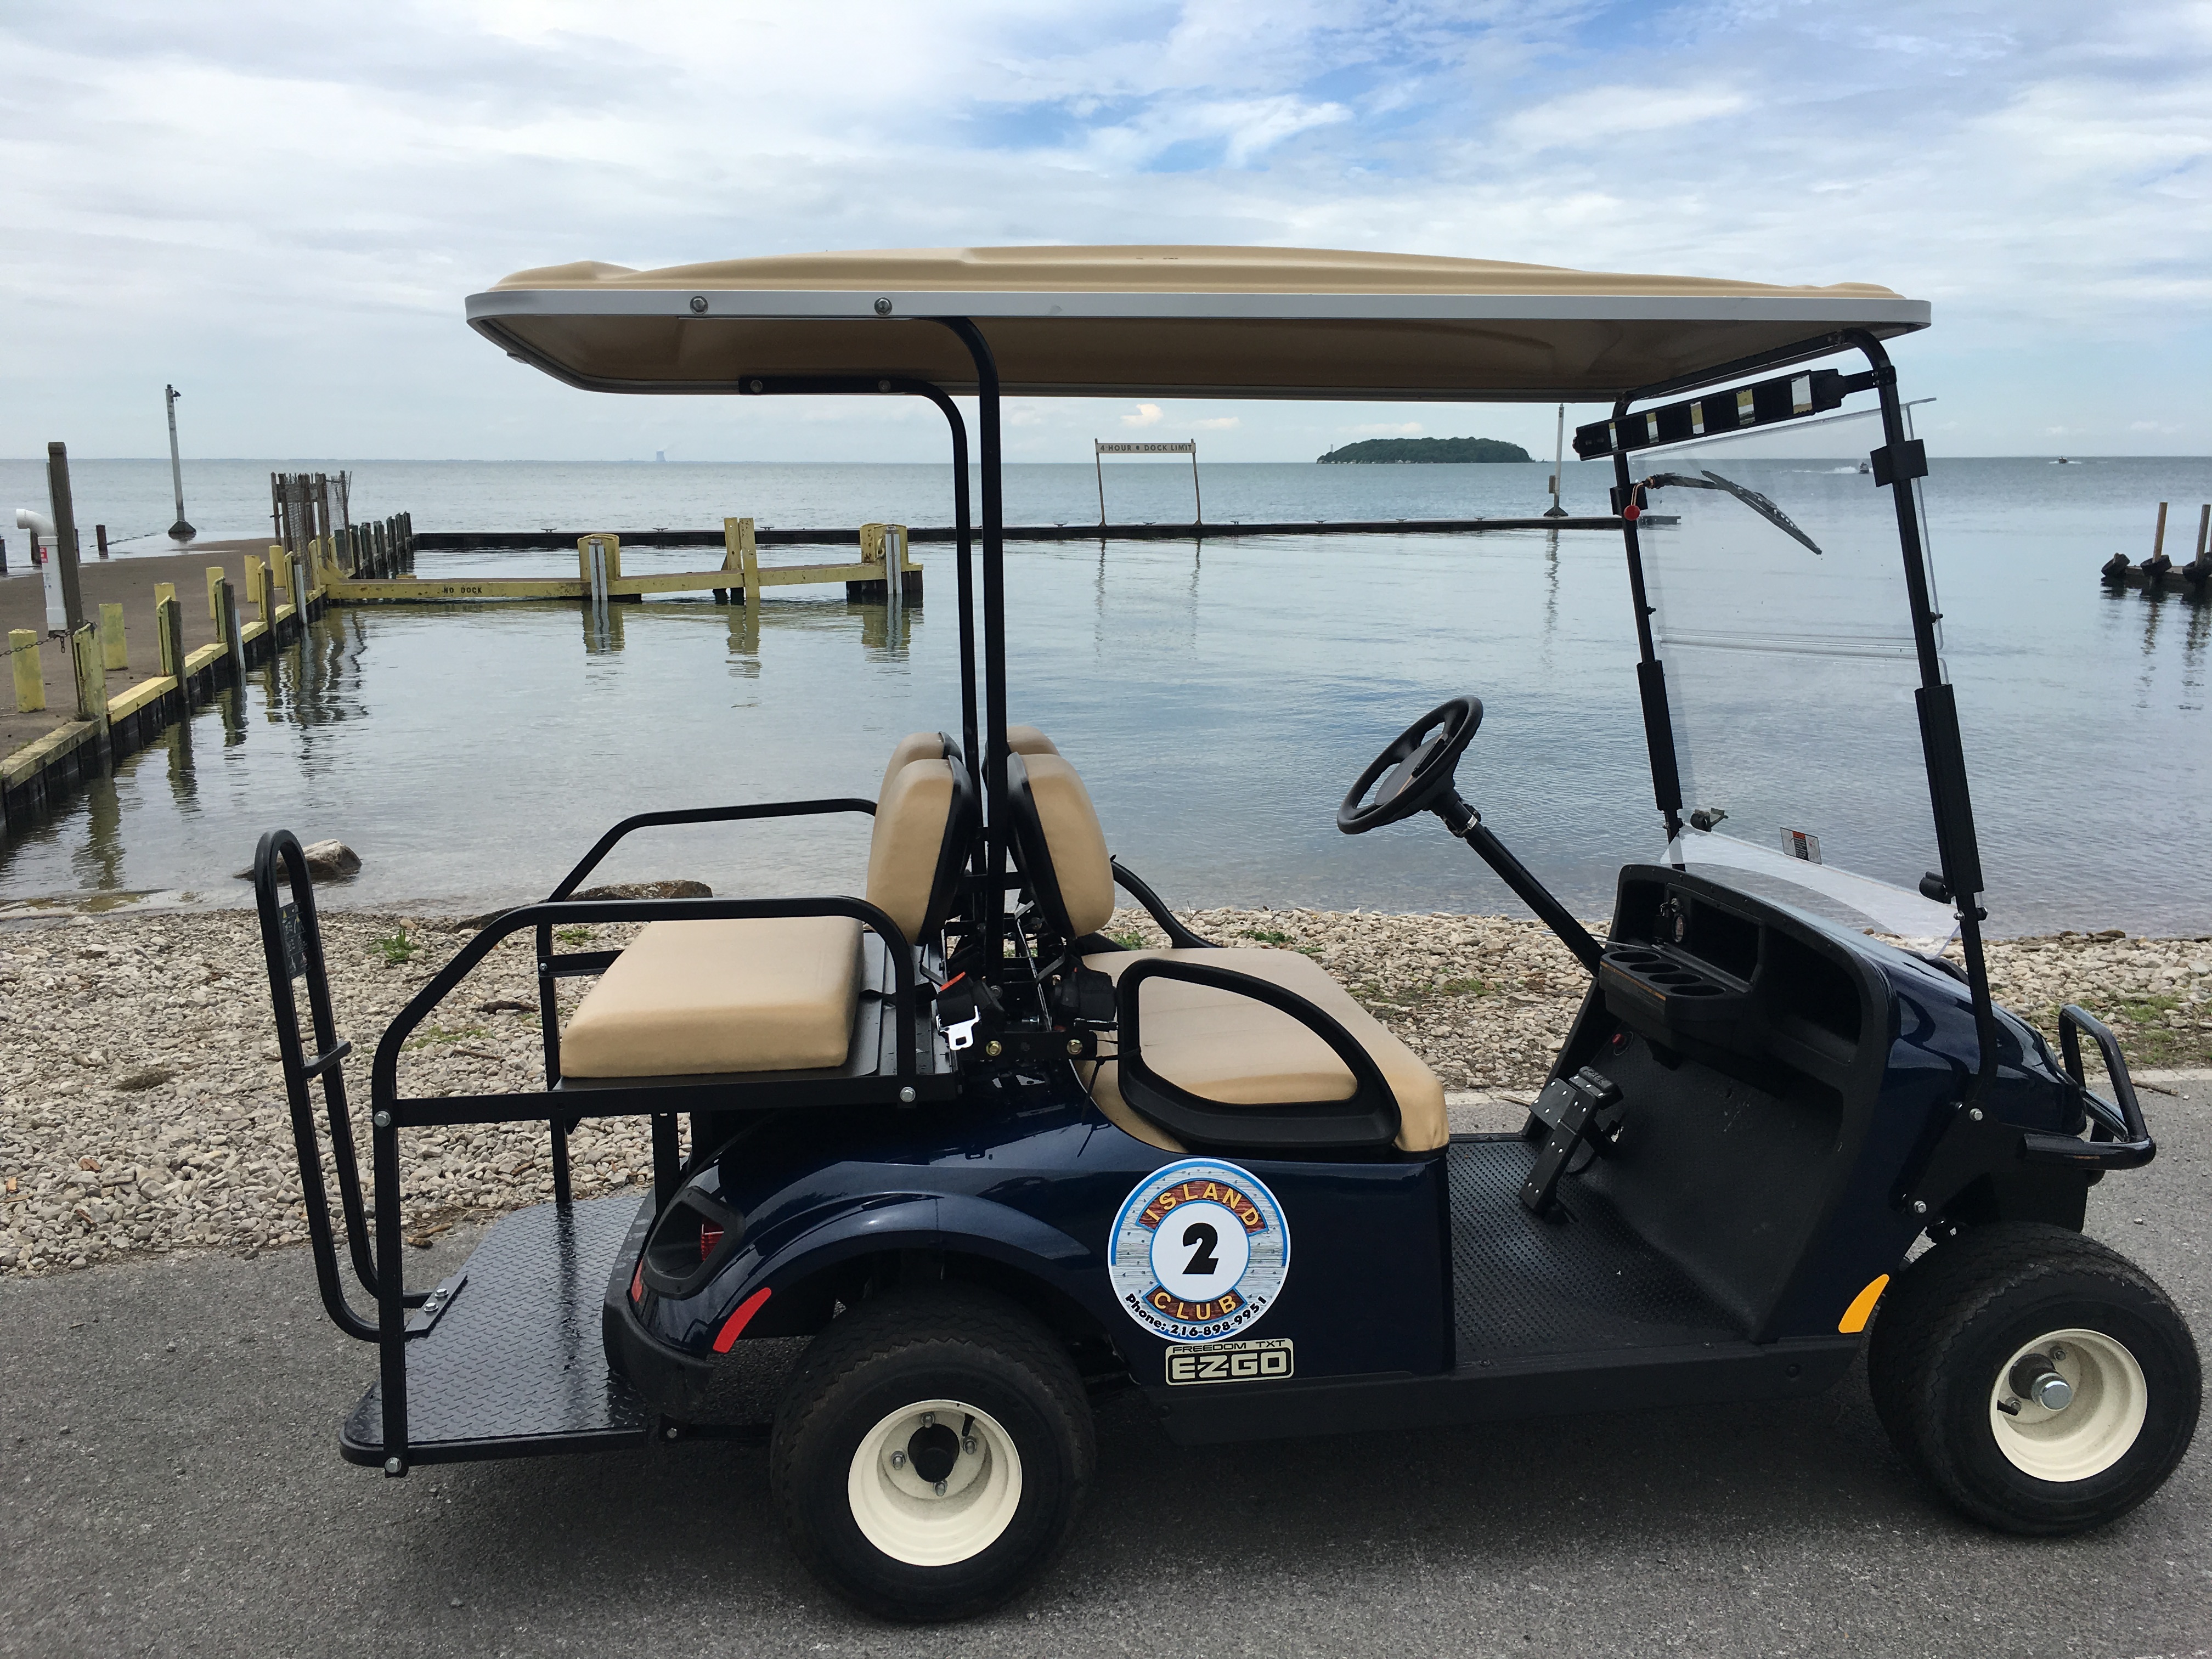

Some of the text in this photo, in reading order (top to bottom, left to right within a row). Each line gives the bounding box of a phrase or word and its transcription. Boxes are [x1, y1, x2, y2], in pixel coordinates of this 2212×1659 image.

[1144, 1182, 1259, 1226] ISLAND
[1182, 1222, 1219, 1274] 2
[1125, 1293, 1268, 1336] Phone: 216-898-9951
[1154, 1292, 1236, 1320] CLUB
[1172, 1339, 1286, 1353] FREEDOM TXT
